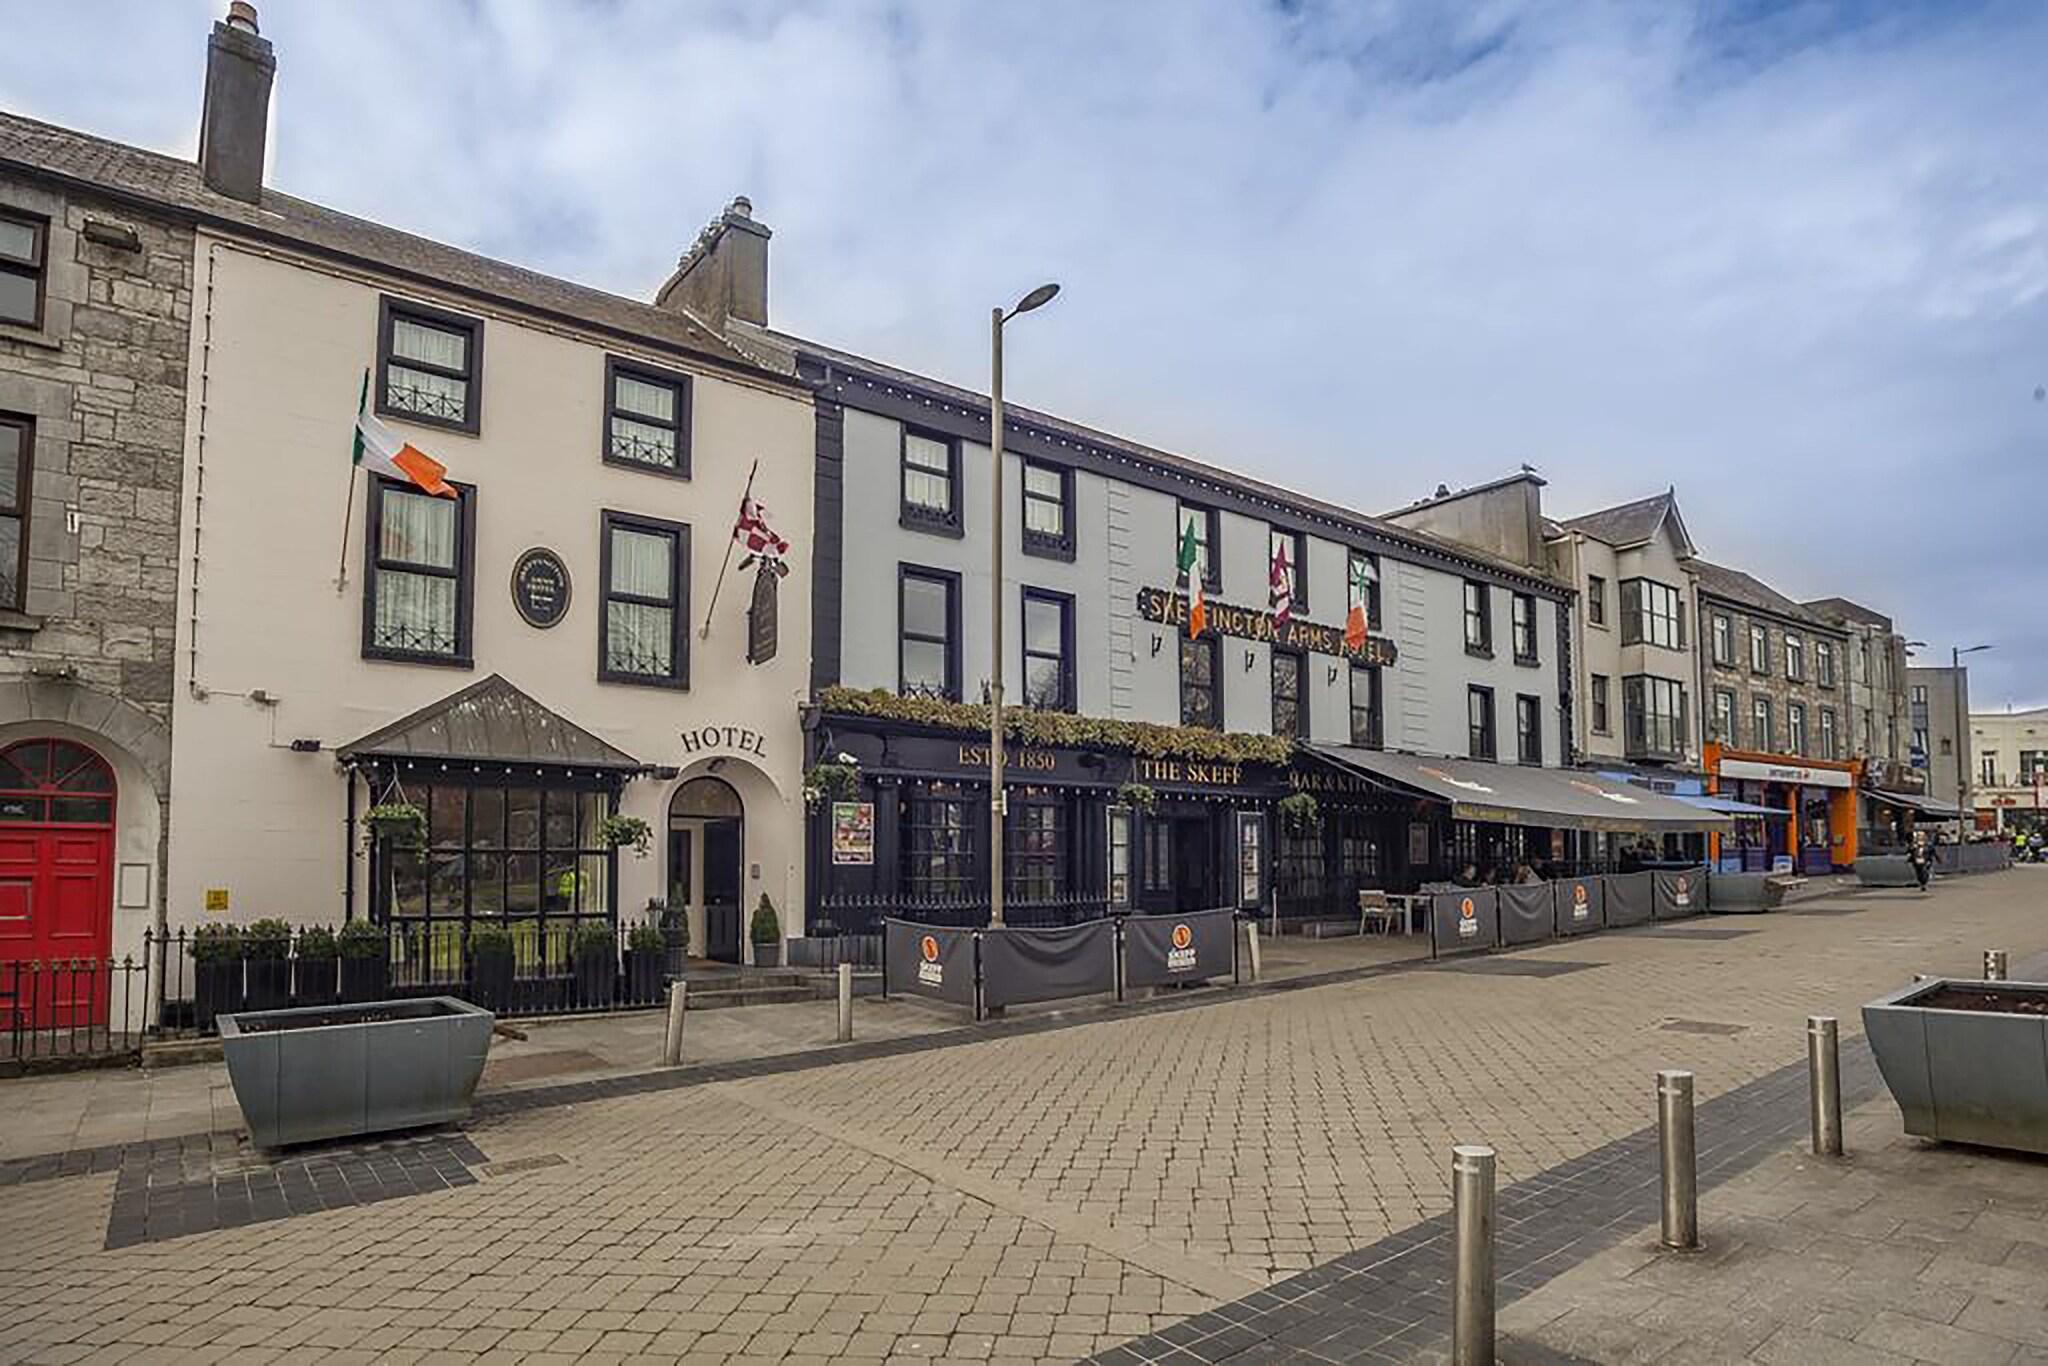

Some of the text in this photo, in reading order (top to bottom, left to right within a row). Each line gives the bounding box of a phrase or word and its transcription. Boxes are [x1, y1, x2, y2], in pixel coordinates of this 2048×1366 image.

[1150, 595, 1386, 664] SKEFINGTON ARMS HTEL
[681, 726, 766, 757] HOTEL
[1018, 751, 1056, 770] 1850
[1142, 760, 1243, 785] THE SKEFF
